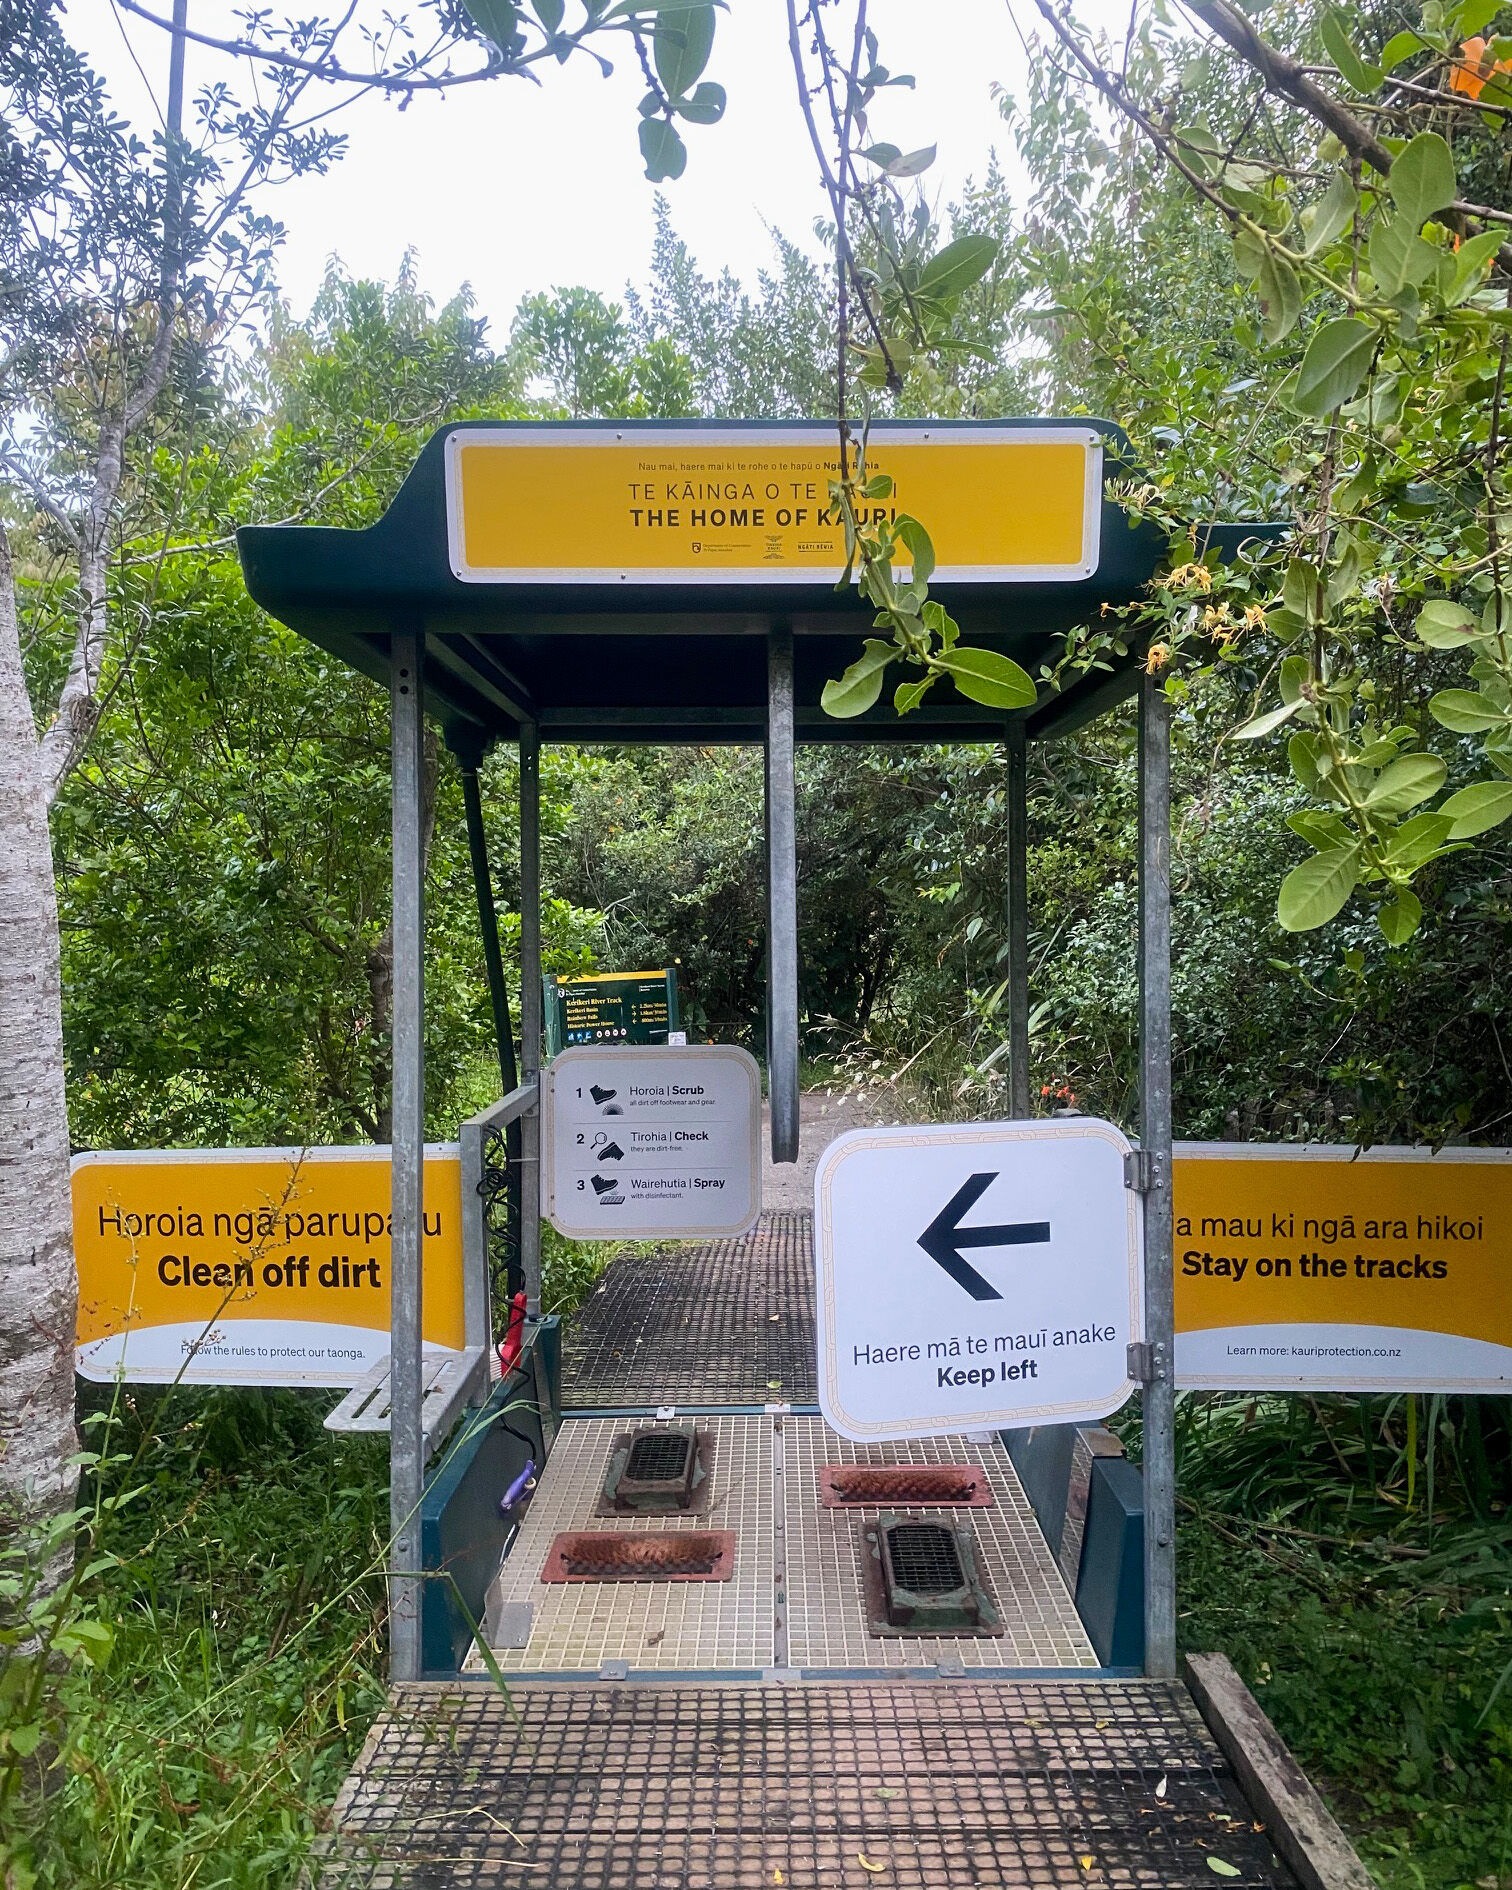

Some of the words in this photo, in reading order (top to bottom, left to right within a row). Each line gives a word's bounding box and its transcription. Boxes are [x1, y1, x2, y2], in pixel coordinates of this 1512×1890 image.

[638, 463, 656, 471] Nau
[659, 462, 678, 472] mai,
[680, 463, 705, 471] haere
[708, 462, 724, 471] mai
[727, 462, 735, 470] ki
[737, 462, 746, 470] te
[749, 462, 769, 470] rohe
[779, 462, 788, 470] te
[790, 462, 813, 473] hapū
[852, 461, 880, 470] Rhia
[628, 483, 656, 500] TE
[666, 481, 755, 500] KĀINGA
[765, 483, 780, 500] O
[790, 483, 817, 500] TE
[629, 509, 680, 527] THE
[691, 508, 765, 527] HOME
[776, 508, 808, 527] OF
[566, 998, 590, 1006] Kerikeri
[606, 996, 623, 1004] Track
[576, 1087, 582, 1098] 1
[629, 1086, 665, 1096] Horoia
[672, 1085, 705, 1095] Scrub
[576, 1133, 585, 1145] 2
[630, 1131, 667, 1142] Tirohia
[674, 1131, 709, 1141] Check
[630, 1145, 644, 1153] they
[576, 1179, 585, 1191] 3
[631, 1178, 687, 1189] Wairehutia
[693, 1178, 726, 1190] Spray
[98, 1206, 205, 1237] Horoia
[214, 1206, 275, 1244] ngā
[285, 1210, 442, 1244] parupu
[1201, 1216, 1262, 1238] mau
[1271, 1212, 1294, 1238] ki
[1303, 1215, 1356, 1244] ngā
[1363, 1219, 1408, 1240] ara
[1417, 1214, 1484, 1241] hikoi
[157, 1254, 254, 1287] Clean
[262, 1255, 310, 1288] off
[318, 1256, 382, 1288] dirt
[1181, 1250, 1249, 1282] Stay
[1255, 1257, 1292, 1278] on
[1298, 1252, 1348, 1278] the
[1354, 1253, 1449, 1280] tracks
[853, 1344, 921, 1366] Haere
[927, 1337, 961, 1359] mā
[965, 1335, 989, 1355] te
[994, 1329, 1048, 1353] mauī
[1052, 1323, 1117, 1347] anake
[1227, 1344, 1257, 1357] Learn
[1259, 1346, 1290, 1357] more:
[1291, 1345, 1402, 1360] kauriprotection.co.nz
[213, 1345, 230, 1356] the
[231, 1346, 255, 1357] rules
[257, 1346, 268, 1357] to
[270, 1346, 307, 1359] protect
[308, 1349, 325, 1358] our
[327, 1348, 366, 1361] taonga.
[937, 1365, 996, 1388] Keep
[1001, 1359, 1039, 1382] left
